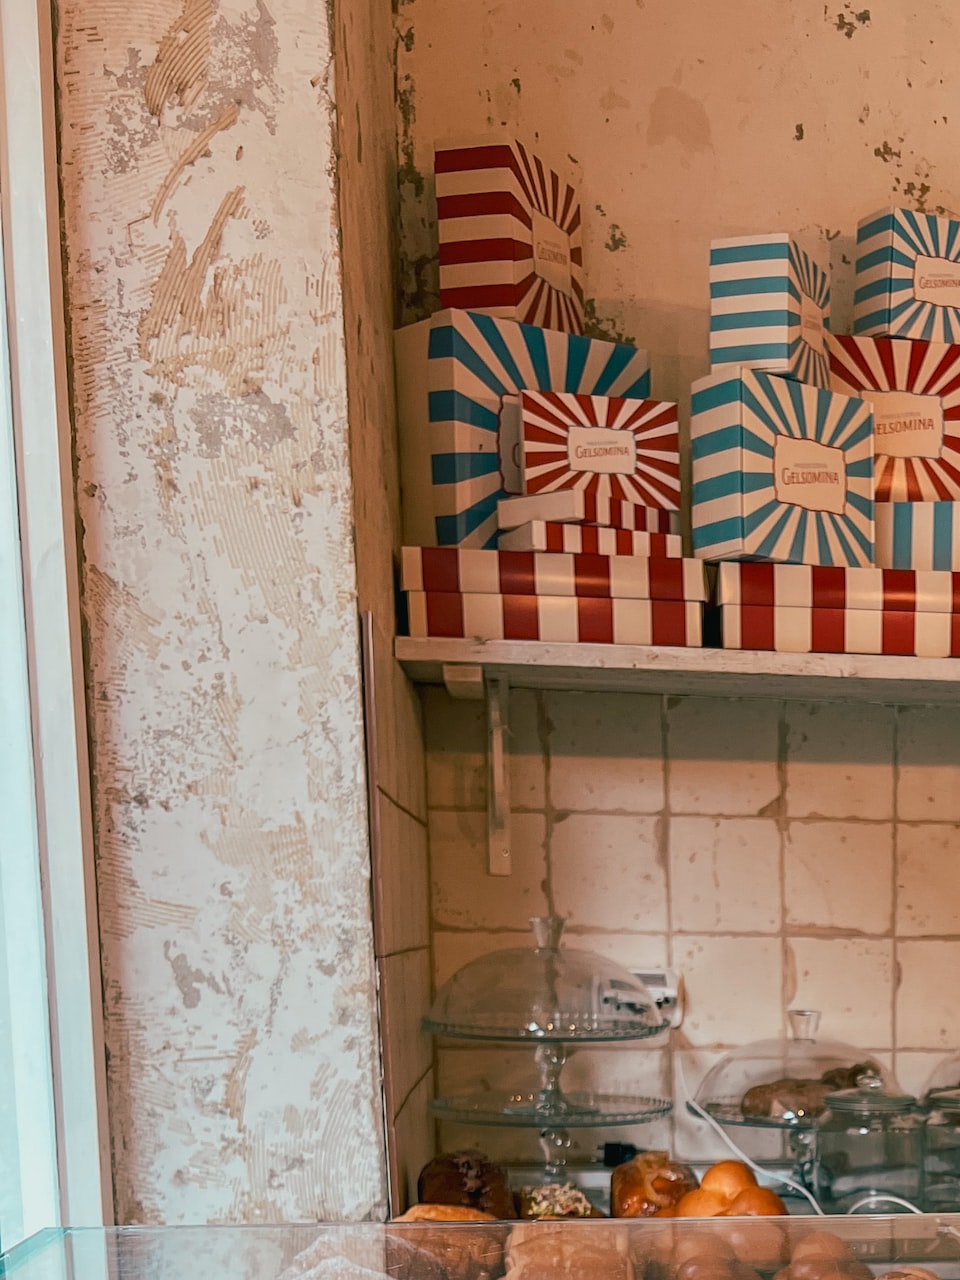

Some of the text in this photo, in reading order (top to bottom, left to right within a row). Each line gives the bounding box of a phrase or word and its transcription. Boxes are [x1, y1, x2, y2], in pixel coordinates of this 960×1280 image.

[875, 418, 935, 435] ELSOMINA
[575, 445, 630, 459] GELSOMINA
[781, 467, 840, 485] GELSOMINA
